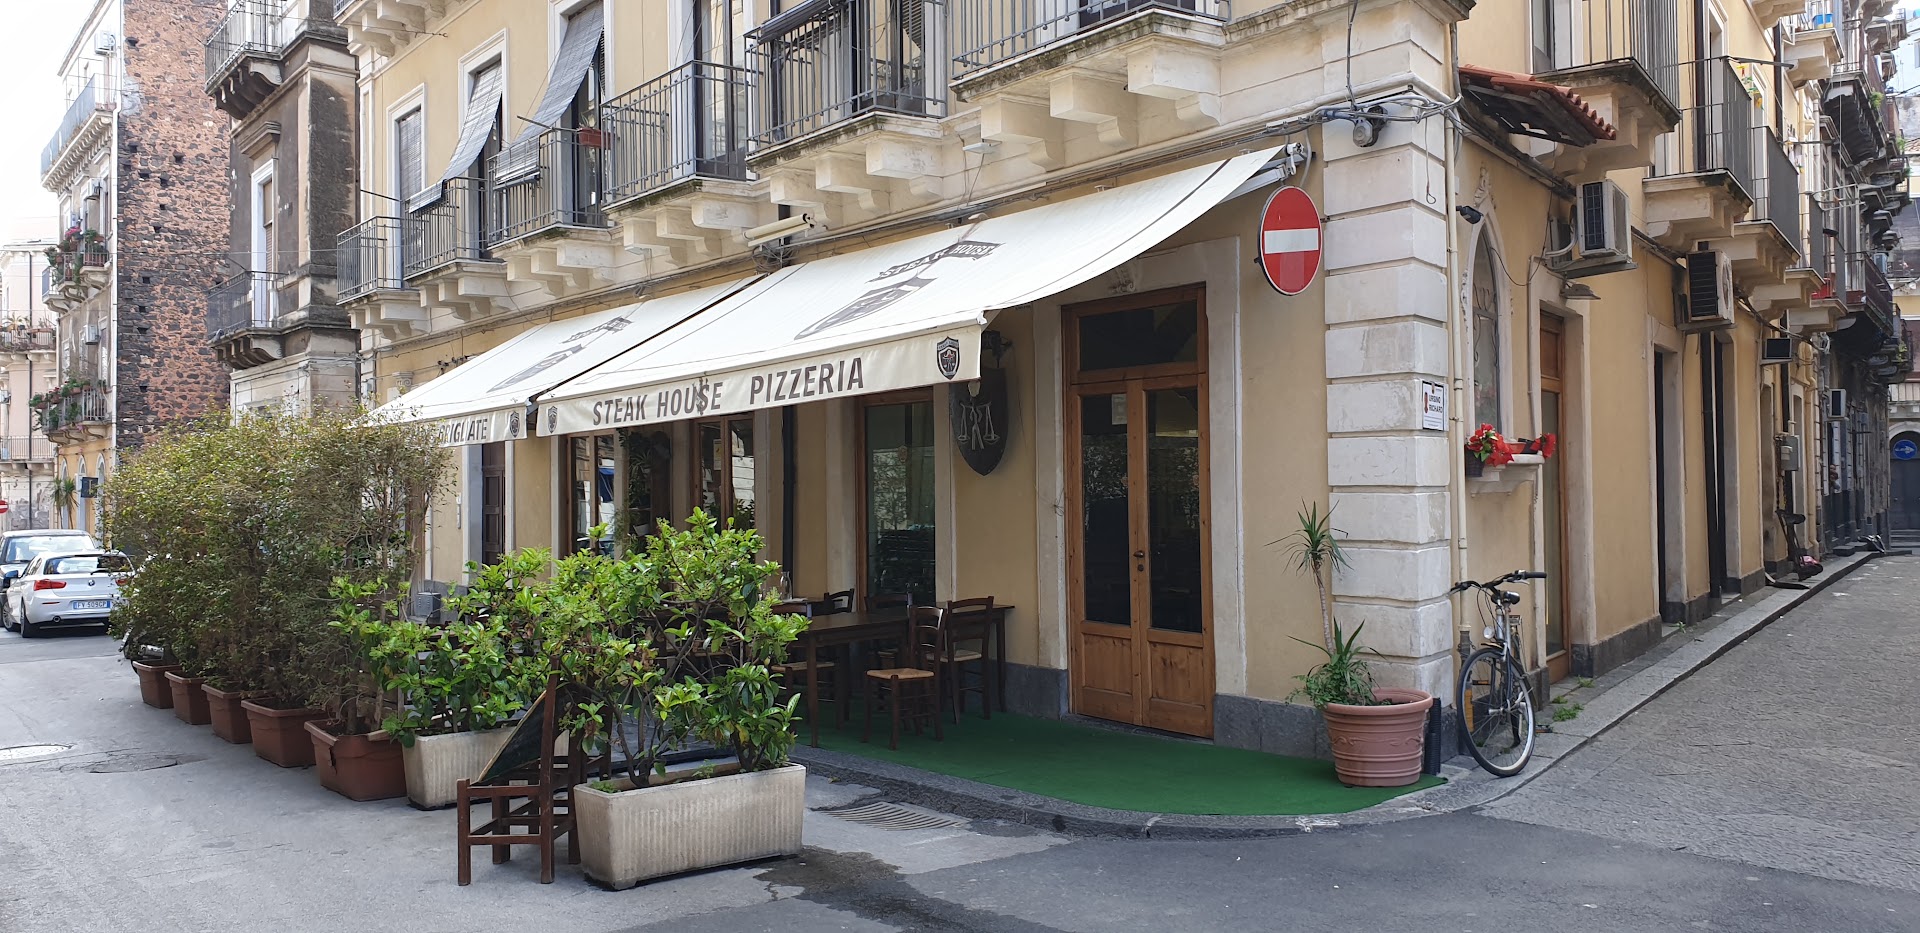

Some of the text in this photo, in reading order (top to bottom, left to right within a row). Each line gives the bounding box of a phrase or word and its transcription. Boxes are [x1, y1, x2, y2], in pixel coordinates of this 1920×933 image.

[879, 244, 995, 277] STEAK HOUSE
[593, 357, 864, 426] STEAK HOUSE PIZZERIA
